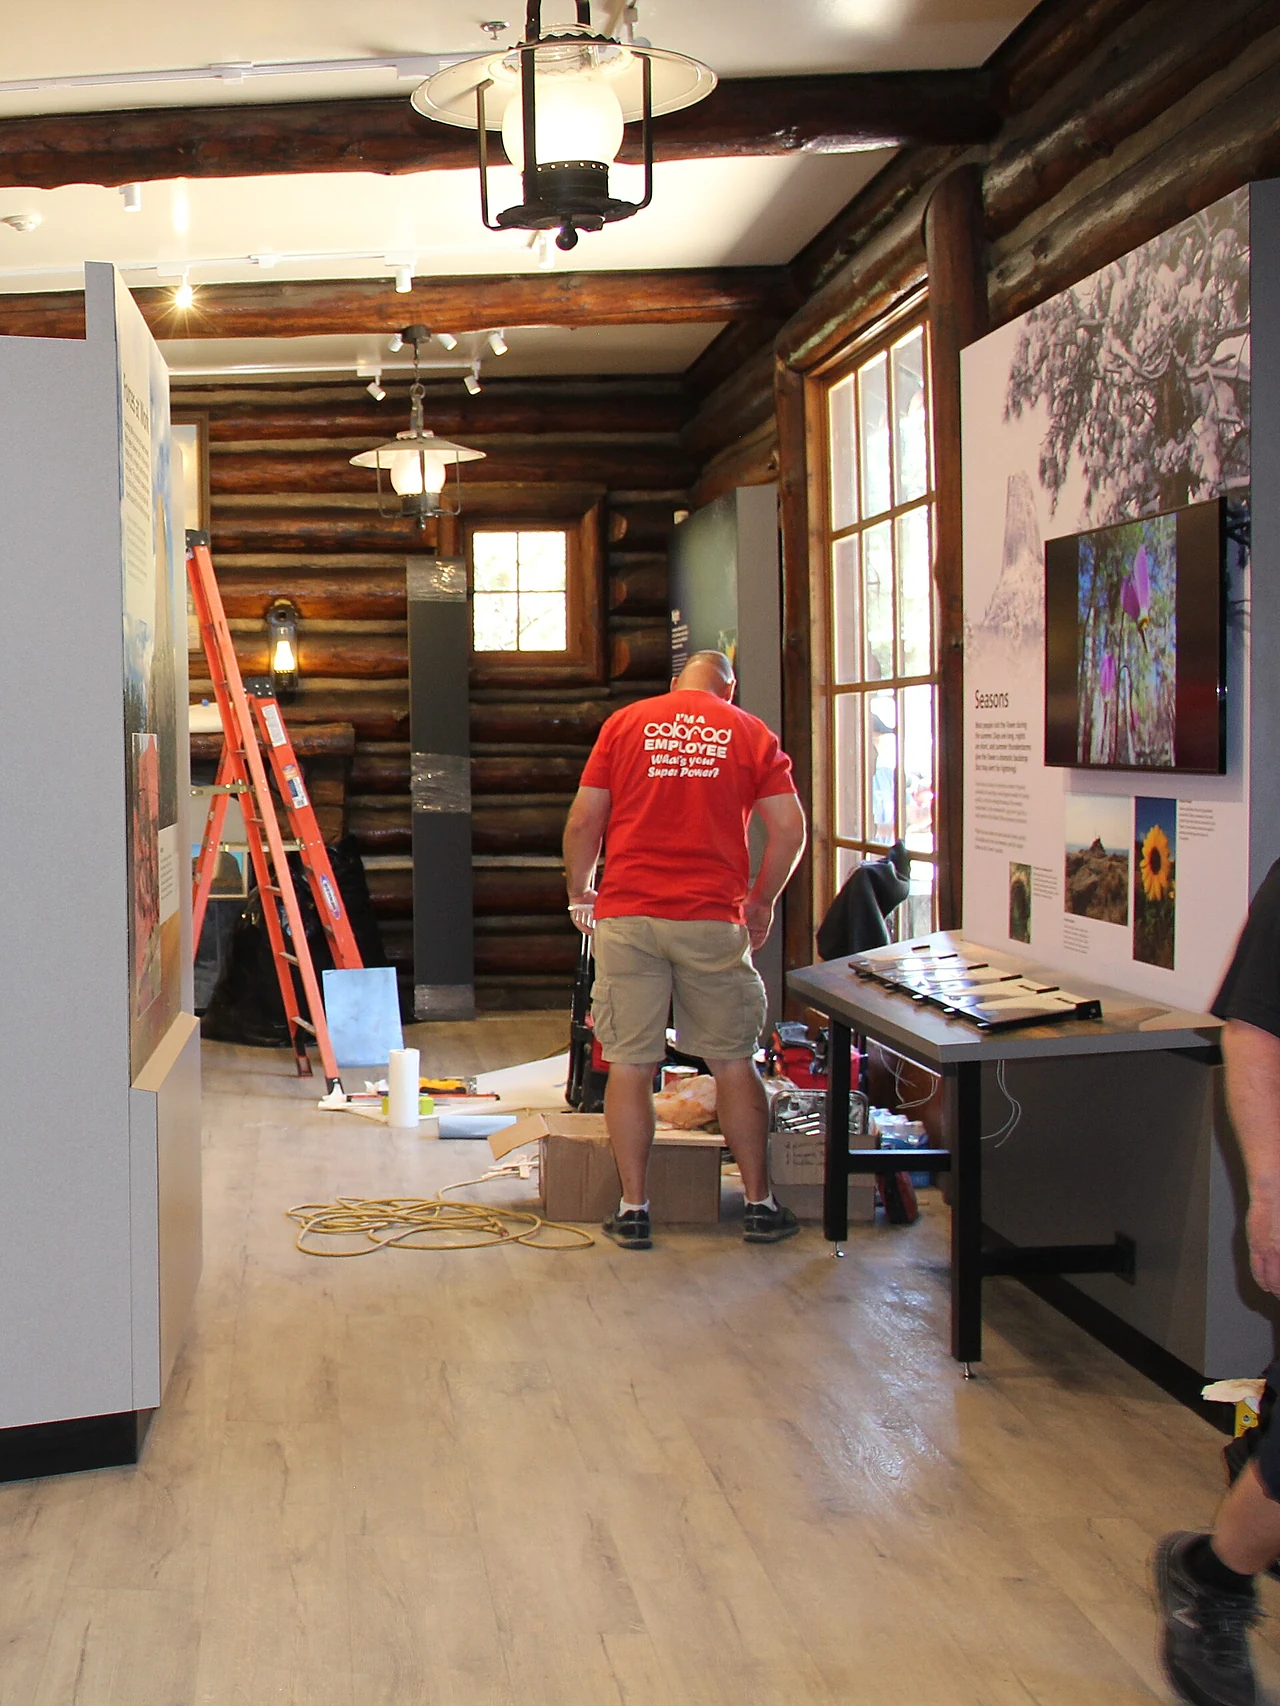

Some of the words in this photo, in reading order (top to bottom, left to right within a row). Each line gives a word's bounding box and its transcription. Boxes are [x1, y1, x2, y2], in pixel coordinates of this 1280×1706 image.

[975, 690, 1009, 709] Seasons
[676, 713, 695, 724] I'M
[696, 715, 705, 724] A
[644, 739, 727, 759] EMPLOYEE
[651, 754, 687, 767] What's
[689, 757, 715, 767] your
[648, 767, 679, 778] Super
[680, 767, 720, 778] Power?
